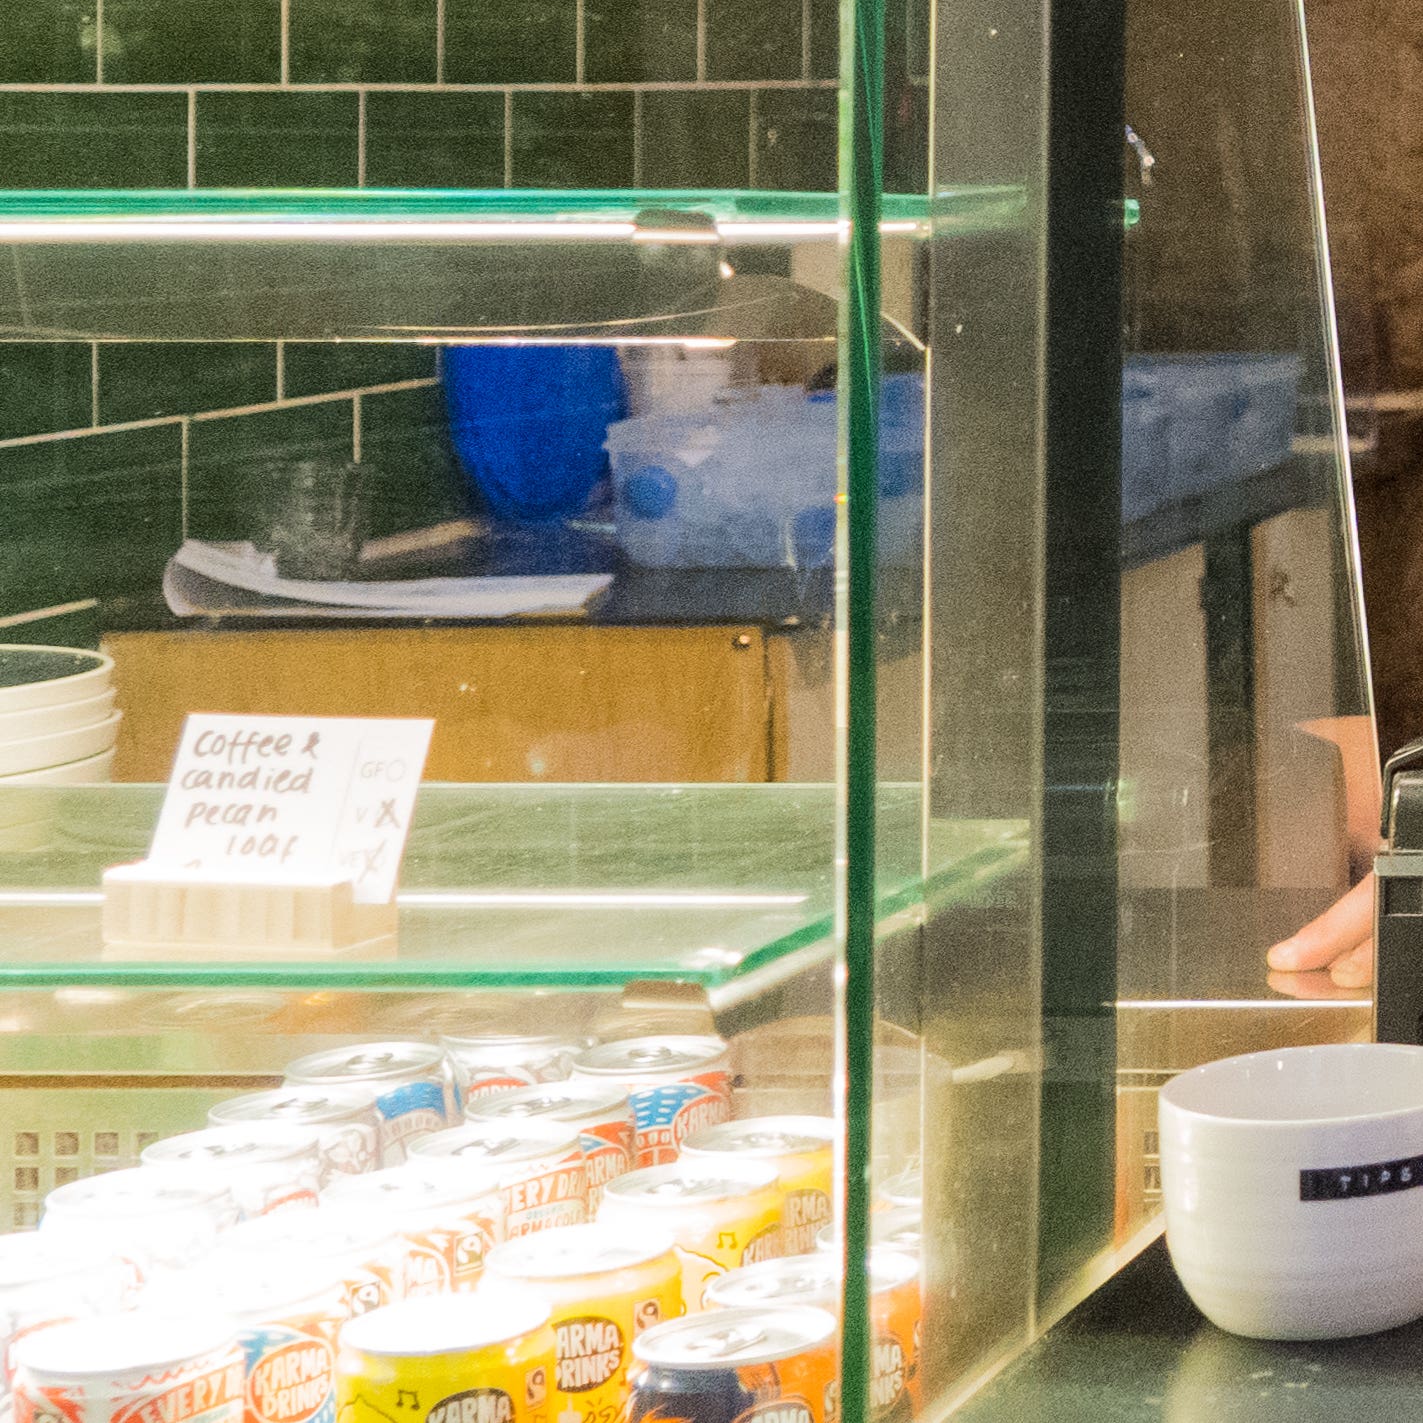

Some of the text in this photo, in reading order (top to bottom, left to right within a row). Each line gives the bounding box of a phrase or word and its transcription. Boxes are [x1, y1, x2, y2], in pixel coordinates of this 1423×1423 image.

[192, 730, 293, 765] Coffee
[180, 766, 314, 795] candied
[1339, 1166, 1413, 1192] TIPS
[254, 1347, 329, 1396] KARMA
